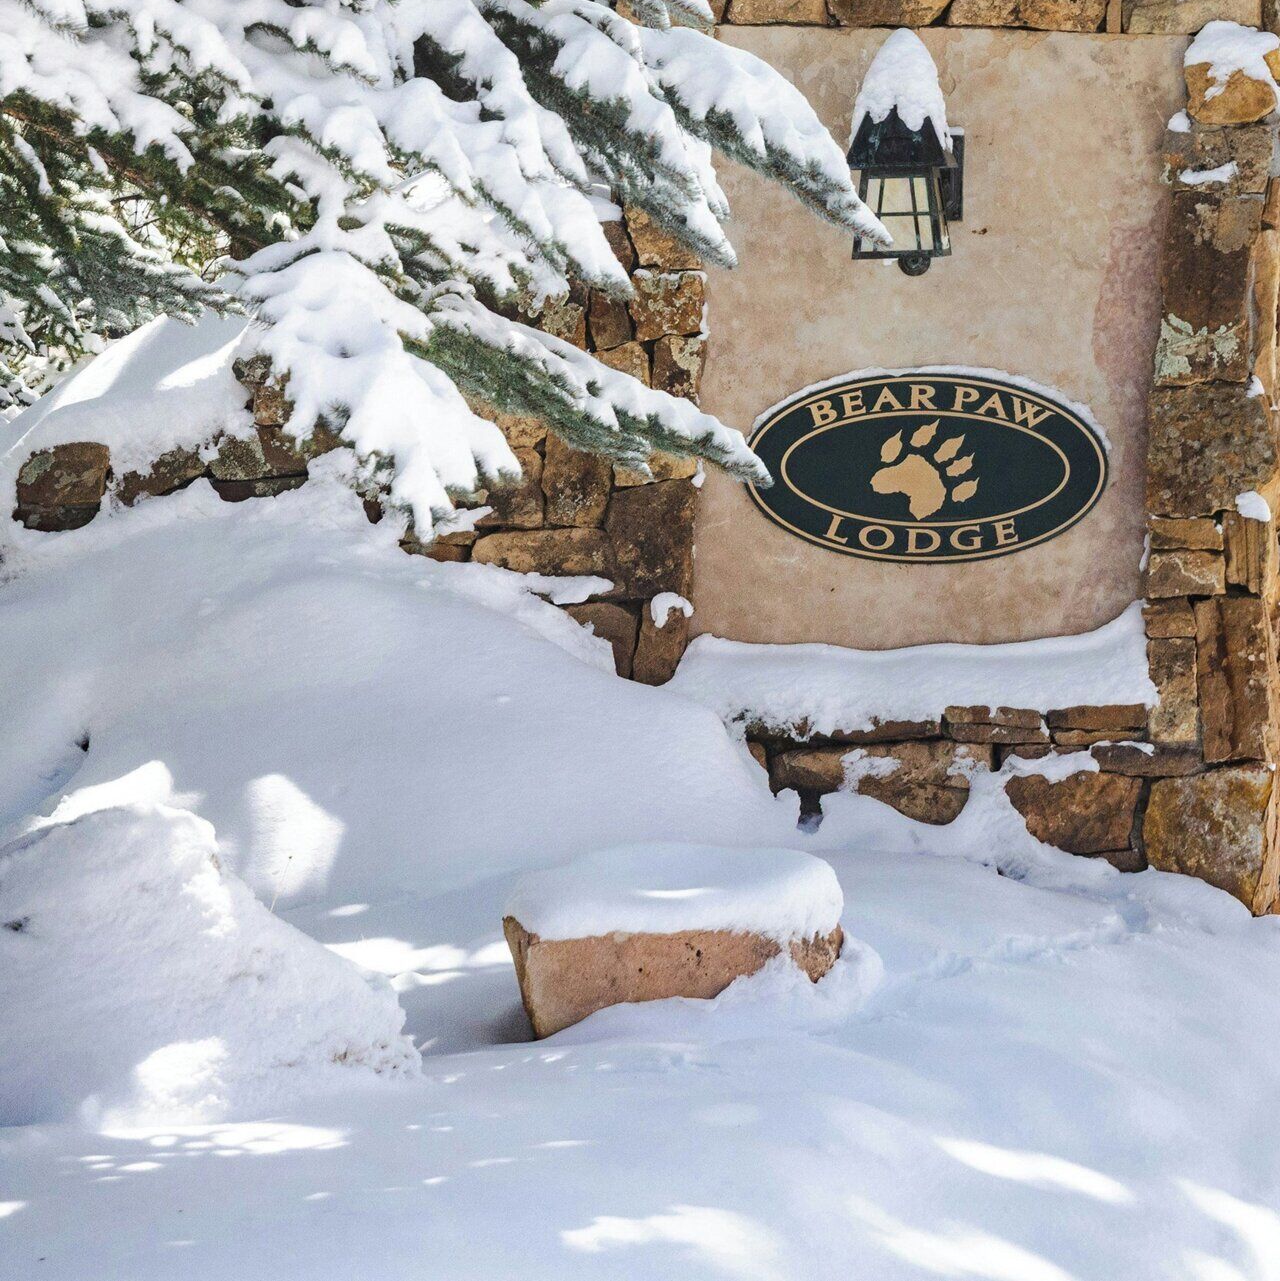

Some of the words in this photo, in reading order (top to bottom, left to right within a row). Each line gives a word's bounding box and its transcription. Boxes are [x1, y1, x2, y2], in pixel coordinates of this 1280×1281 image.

[805, 384, 936, 428] BEAR
[953, 385, 1057, 428] PAW
[822, 513, 1020, 553] LODGE
